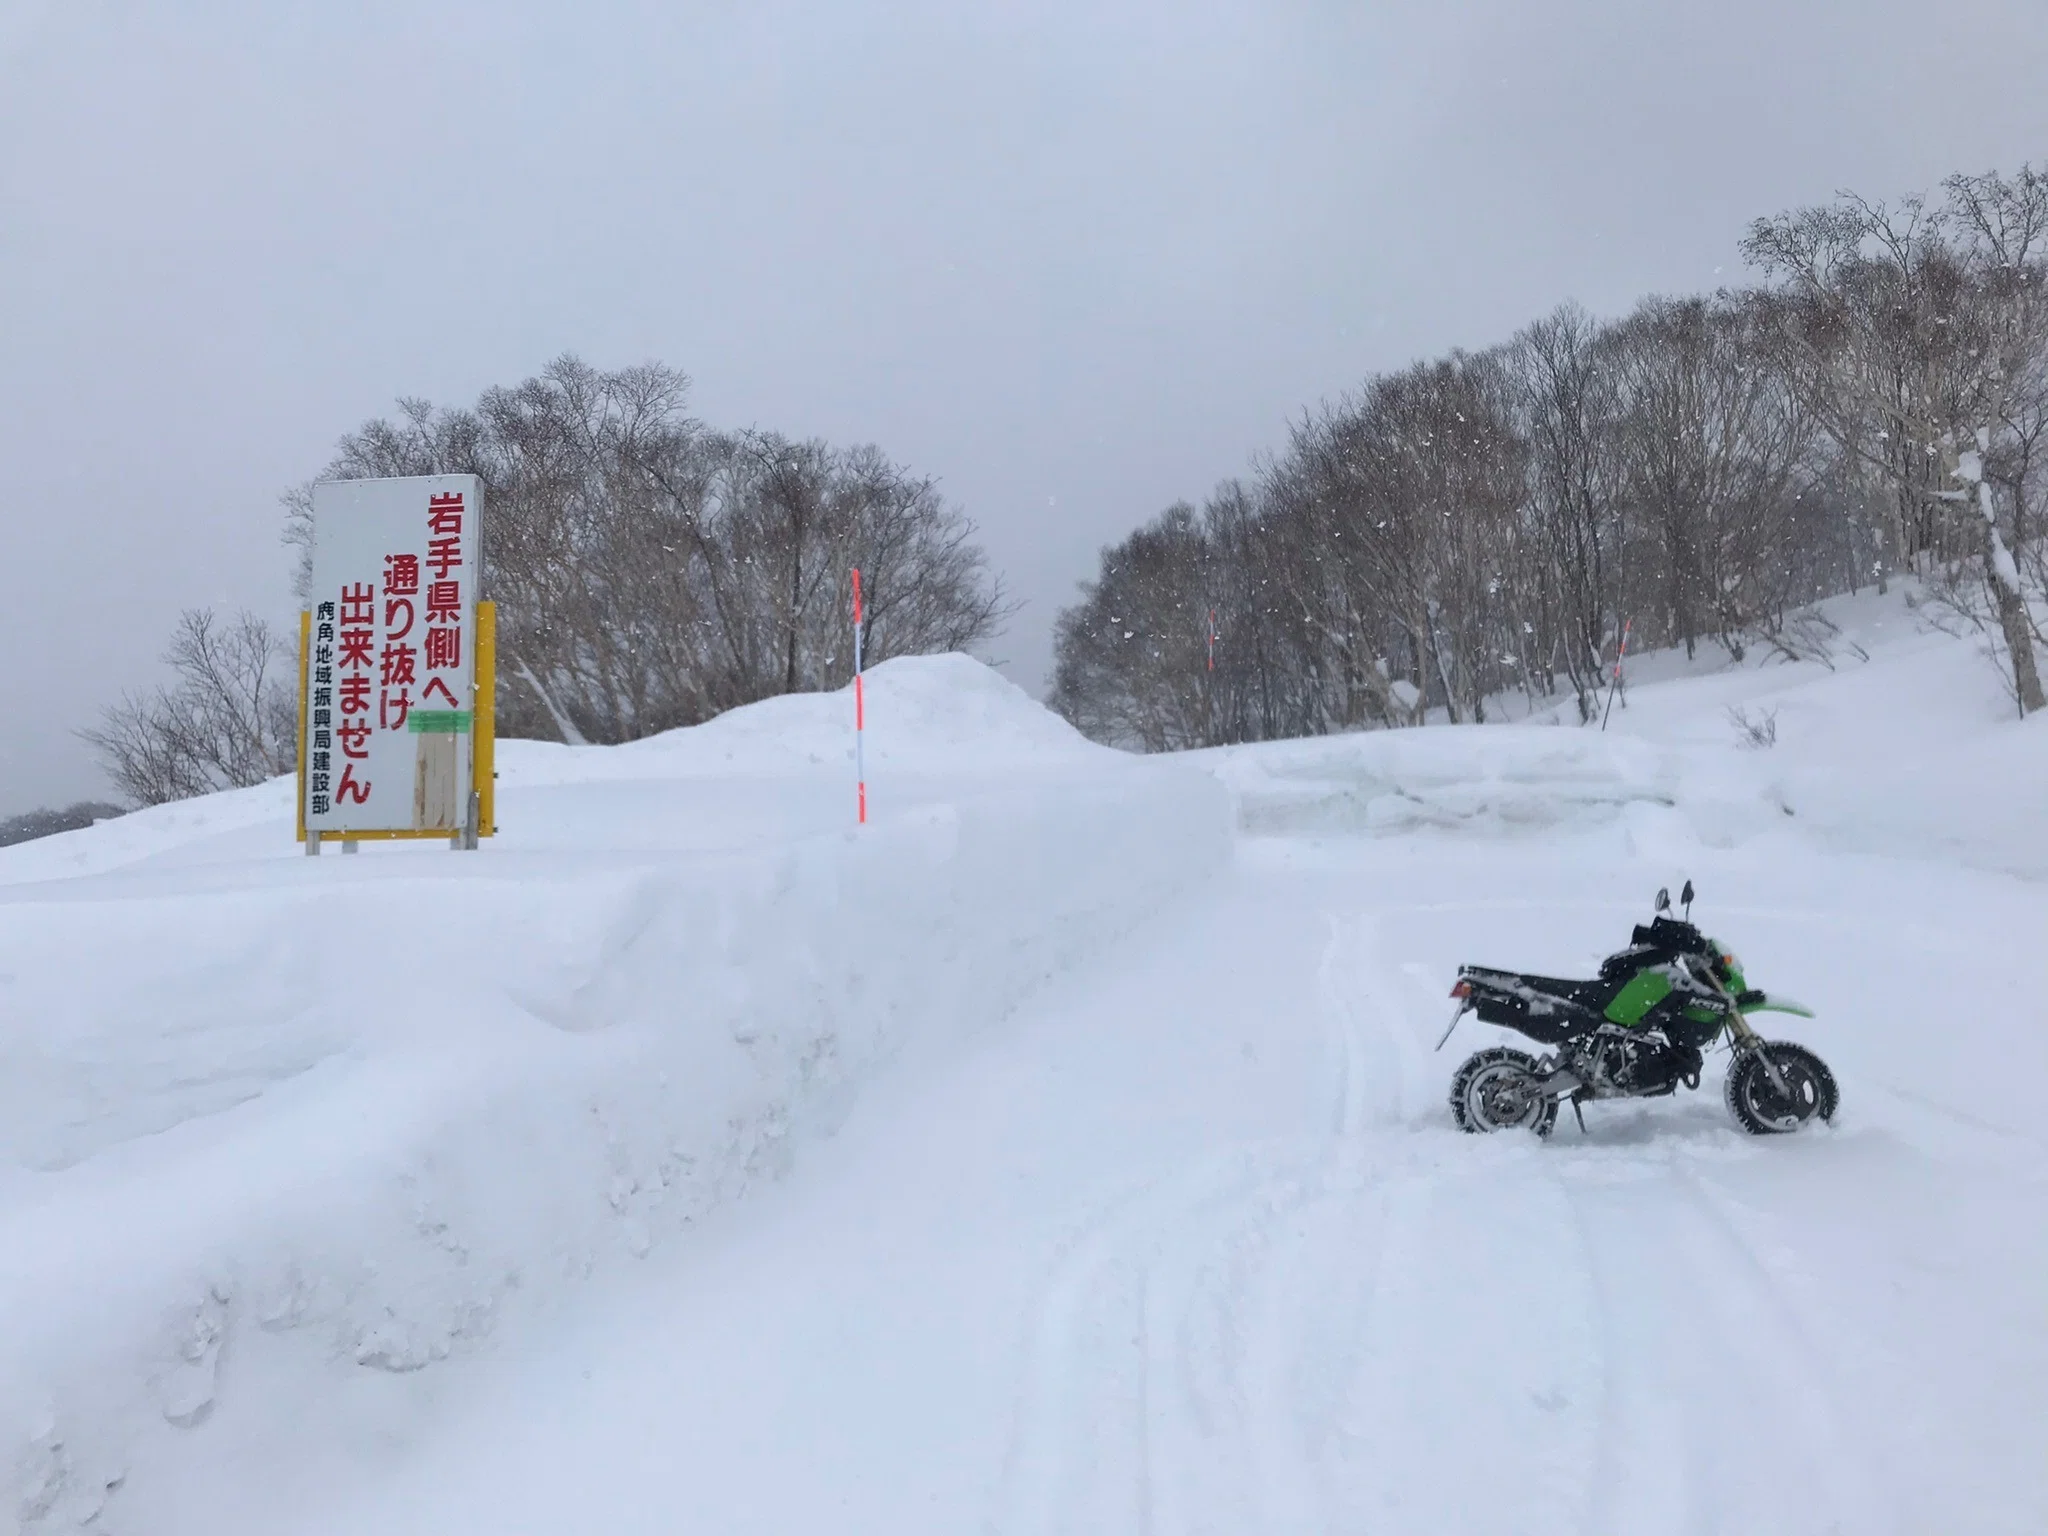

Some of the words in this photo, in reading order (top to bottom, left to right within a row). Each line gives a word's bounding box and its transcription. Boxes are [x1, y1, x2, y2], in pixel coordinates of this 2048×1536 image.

[336, 582, 374, 805] 出来ません
[380, 553, 419, 730] 通り抜け
[422, 491, 464, 707] 岩手県側へ
[311, 600, 335, 815] 鹿角地域振興局建設部
